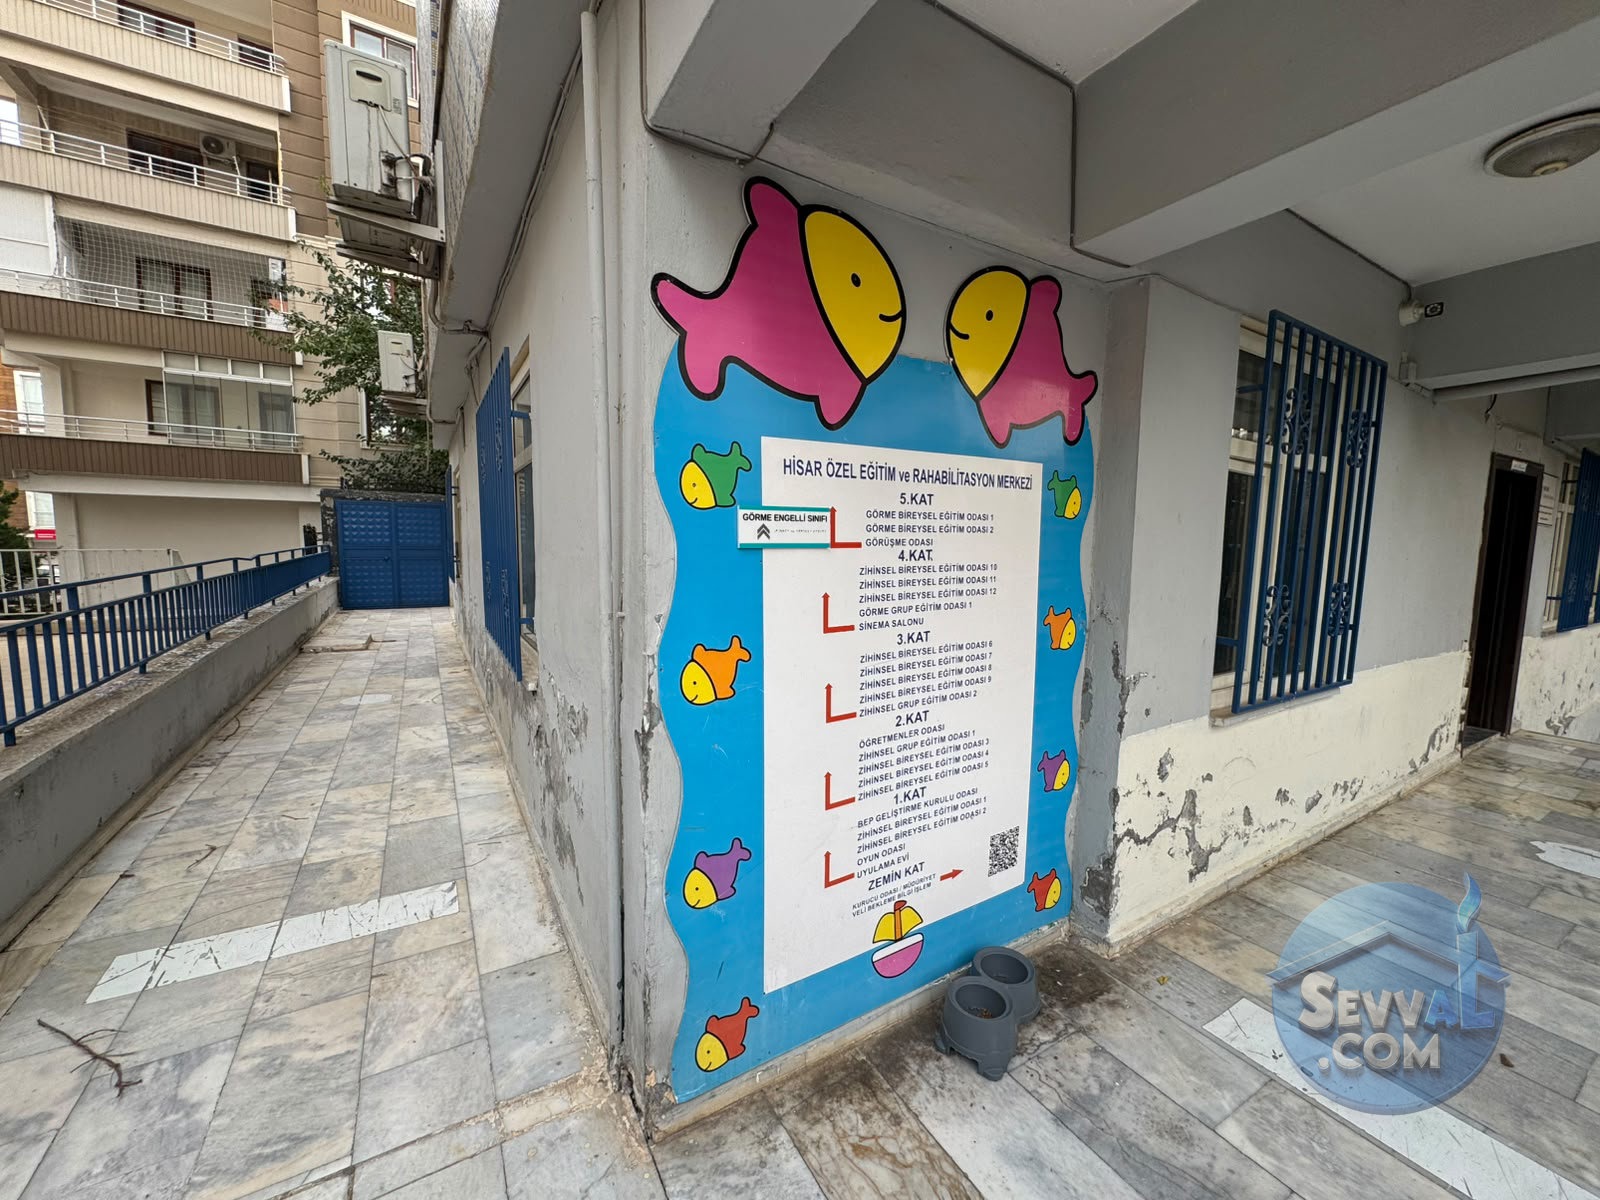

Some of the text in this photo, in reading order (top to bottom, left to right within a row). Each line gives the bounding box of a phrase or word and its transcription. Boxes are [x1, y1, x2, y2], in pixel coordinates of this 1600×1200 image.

[783, 455, 1033, 491] HİSAR ÖZEL EĞİTİM ve RAHABİLİTASYON MERKEZİ
[900, 493, 934, 505] 5.KAT
[743, 512, 772, 521] GÖRME
[774, 514, 805, 522] ENGELLİ
[866, 510, 896, 519] GÖRME
[898, 510, 937, 520] BİREYSEL
[939, 511, 964, 520] EĞİTİM
[967, 513, 988, 521] ODASI
[866, 523, 896, 532] GÖRME
[898, 525, 937, 533] BİREYSEL
[939, 524, 964, 533] EĞİTİM
[865, 537, 934, 547] GÖRÜŞME ODASI
[860, 566, 896, 575] ZİHİNSEL
[898, 565, 937, 574] BİREYSEL
[939, 564, 964, 572] EĞİTİM
[860, 580, 896, 589] ZİHİNSEL
[898, 578, 936, 587] BİREYSEL
[939, 577, 964, 585] EĞİTİM
[966, 576, 988, 584] ODASI
[859, 594, 895, 603] ZİHİNSEL
[898, 591, 936, 600] BİREYSEL
[938, 590, 963, 598] EĞİTİM
[965, 588, 987, 596] ODASI
[859, 607, 889, 617] GÖRME
[891, 606, 913, 614] GRUP
[915, 604, 941, 612] EĞİTİM
[944, 602, 966, 610] ODASI
[859, 618, 924, 631] SİNEMA SALONU
[897, 631, 930, 645] 3.KAT
[860, 652, 896, 663] ZİHİNSEL
[898, 647, 936, 658] BİREYSEL
[939, 644, 963, 653] EĞİTİM
[965, 641, 987, 650] ODASI
[860, 665, 896, 677] ZİHİNSEL
[898, 660, 936, 671] BİREYSEL
[938, 656, 963, 665] EĞİTİM
[965, 653, 987, 662] ODASI
[860, 678, 896, 690] ZİHİNSEL
[898, 672, 936, 684] BİREYSEL
[938, 668, 963, 678] EĞİTİM
[965, 665, 986, 674] ODASI
[860, 691, 896, 704] ZİHİNSEL
[898, 685, 936, 697] BİREYSEL
[938, 680, 963, 690] EĞİTİM
[965, 677, 986, 686] ODASI
[860, 704, 895, 717] ZİHİNSEL
[898, 699, 919, 709] GRUP
[922, 695, 947, 705] EĞİTİM
[949, 691, 971, 700] ODASI
[896, 710, 929, 727] 2.KAT
[921, 724, 944, 735] ODASI
[859, 747, 894, 762] ZİHİNSEL
[897, 741, 918, 752] GRUP
[920, 736, 946, 747] EĞİTİM
[948, 731, 970, 741] ODASI
[859, 760, 894, 775] ZİHİNSEL
[896, 751, 934, 765] BİREYSEL
[936, 744, 961, 756] EĞİTİM
[963, 740, 984, 750] ODASI
[858, 772, 894, 788] ZİHİNSEL
[896, 763, 933, 777] BİREYSEL
[935, 756, 960, 768] EĞİTİM
[962, 751, 983, 761] ODASI
[858, 785, 893, 801] ZİHİNSEL
[896, 775, 933, 790] BİREYSEL
[935, 768, 960, 780] EĞİTİM
[962, 762, 983, 773] ODASI
[894, 786, 926, 804] 1.KAT
[858, 788, 977, 828] BEP GELİŞTİRME KURULU ODASI
[858, 824, 893, 841] ZİHİNSEL
[895, 812, 932, 828] BİREYSEL
[934, 804, 959, 817] EĞİTİM
[960, 798, 981, 809] ODASI
[857, 836, 892, 853] ZİHİNSEL
[895, 824, 931, 840] BİREYSEL
[934, 816, 958, 828] EĞİTİM
[960, 809, 981, 820] ODASI
[857, 843, 905, 865] OYUN ODASI
[857, 853, 909, 878] UYULAMA EVİ
[868, 862, 925, 891] ZEMİN KAT
